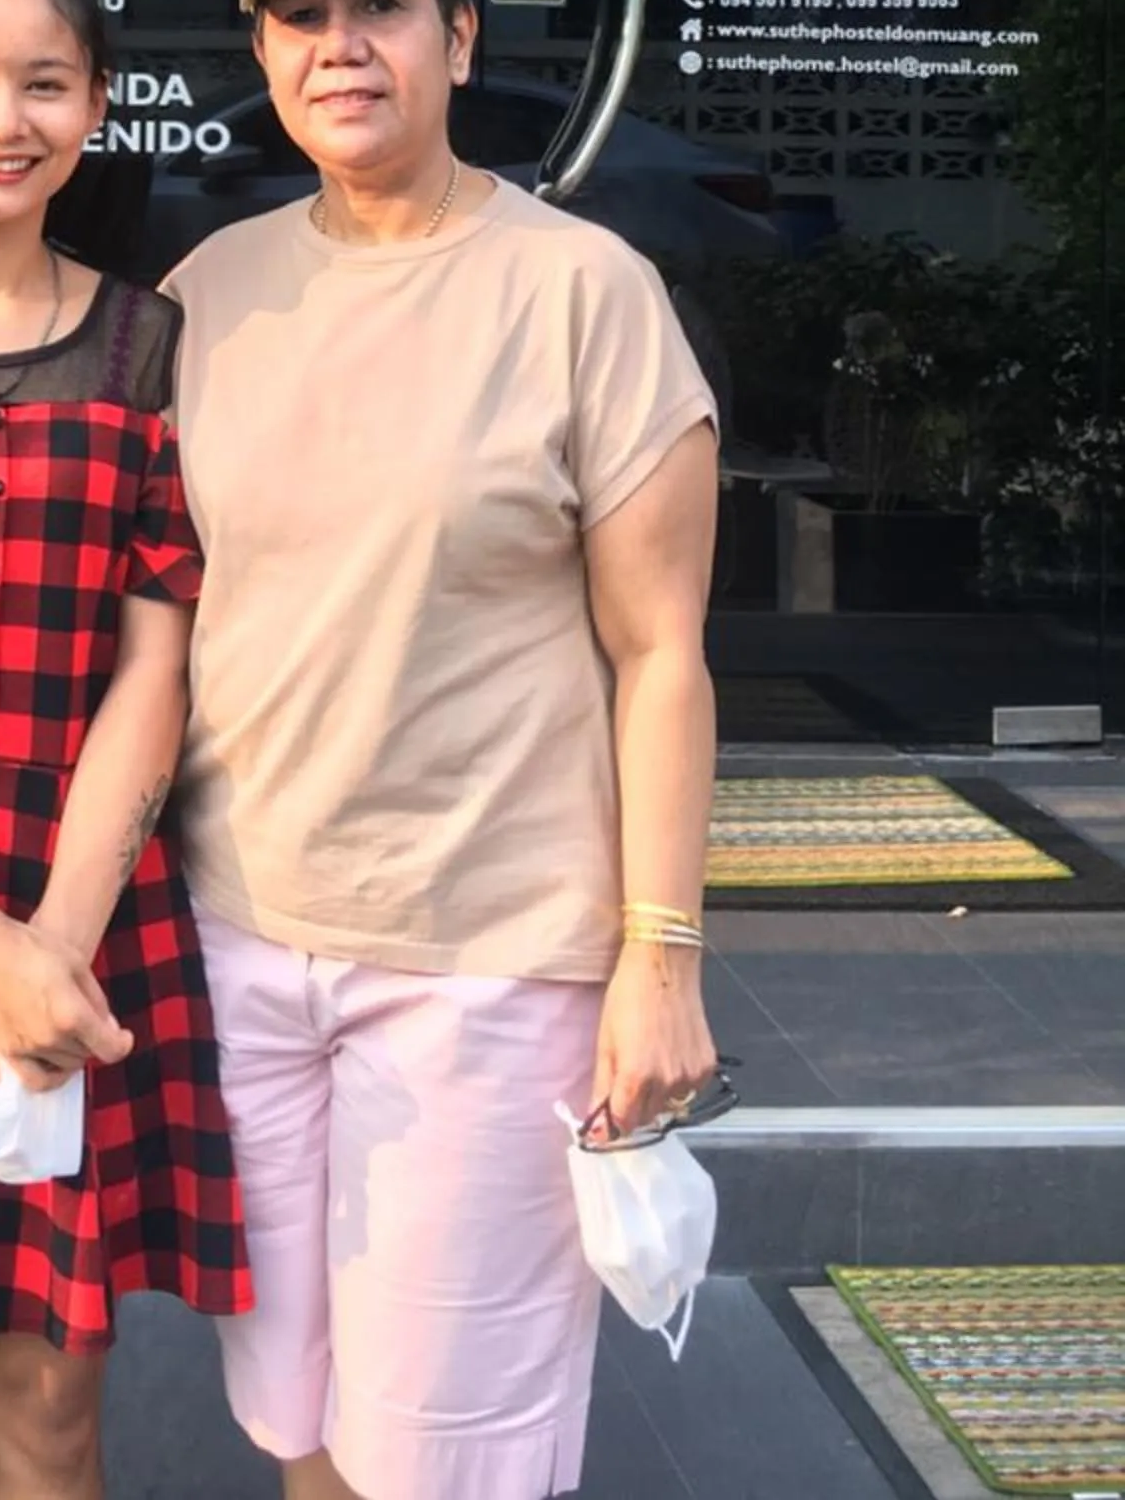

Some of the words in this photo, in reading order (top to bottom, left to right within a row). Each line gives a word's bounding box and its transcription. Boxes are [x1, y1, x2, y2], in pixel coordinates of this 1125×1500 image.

[716, 22, 1041, 48] www.suthephosteldonmuang.com
[716, 53, 1020, 79] suthephome.hostel@gmail.com
[82, 119, 232, 155] ENIDO
